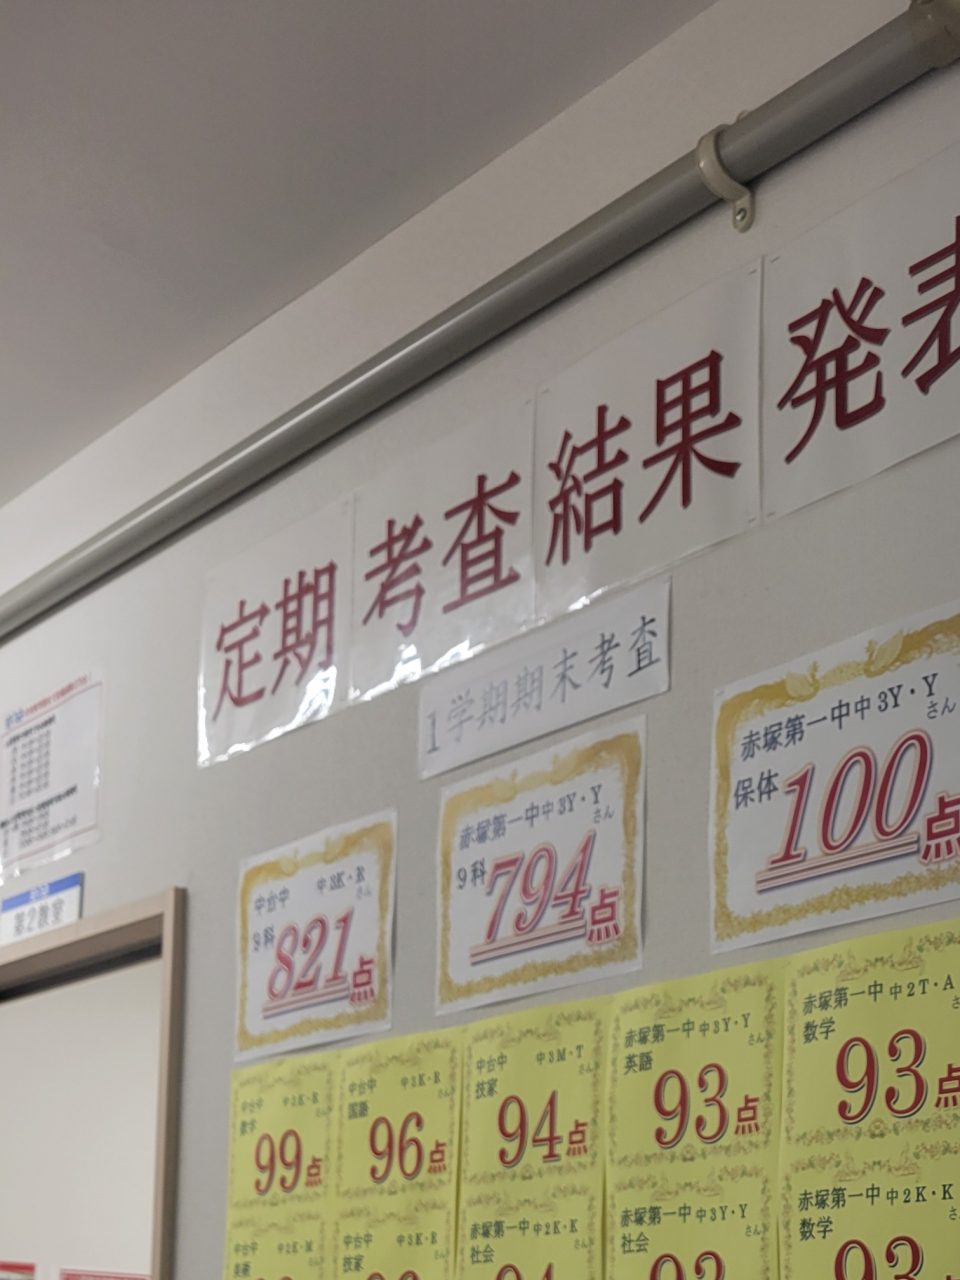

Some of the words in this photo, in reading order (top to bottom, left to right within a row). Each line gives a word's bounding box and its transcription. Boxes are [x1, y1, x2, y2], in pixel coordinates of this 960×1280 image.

[427, 616, 661, 754] 1学期期末考査
[926, 697, 956, 719] さん
[740, 699, 850, 761] 赤塚第一中
[733, 768, 779, 809] 保体
[593, 805, 615, 824] さん
[457, 858, 486, 890] 9科
[485, 828, 621, 945] 794点
[267, 906, 374, 1004] 821点
[802, 980, 884, 1014] 赤塚第一中
[889, 975, 954, 1001] 中2T・A
[624, 1018, 696, 1048] 赤塚第一中
[802, 1017, 836, 1044] 数学
[476, 1054, 508, 1074] 中台中
[623, 1051, 653, 1075] 英語
[475, 1078, 498, 1100] 技家
[653, 1062, 760, 1149] 93点
[498, 1090, 588, 1168] 94点
[368, 1111, 447, 1183] 96点
[254, 1129, 322, 1195] 99点
[798, 1182, 880, 1211] 赤塚第一中
[885, 1182, 954, 1205] 中2K・K
[470, 1220, 530, 1240] 赤塚第一中
[620, 1203, 691, 1228] 赤塚第一中
[798, 1215, 834, 1242] 数学
[470, 1244, 495, 1265] 社会
[620, 1231, 649, 1255] 社会
